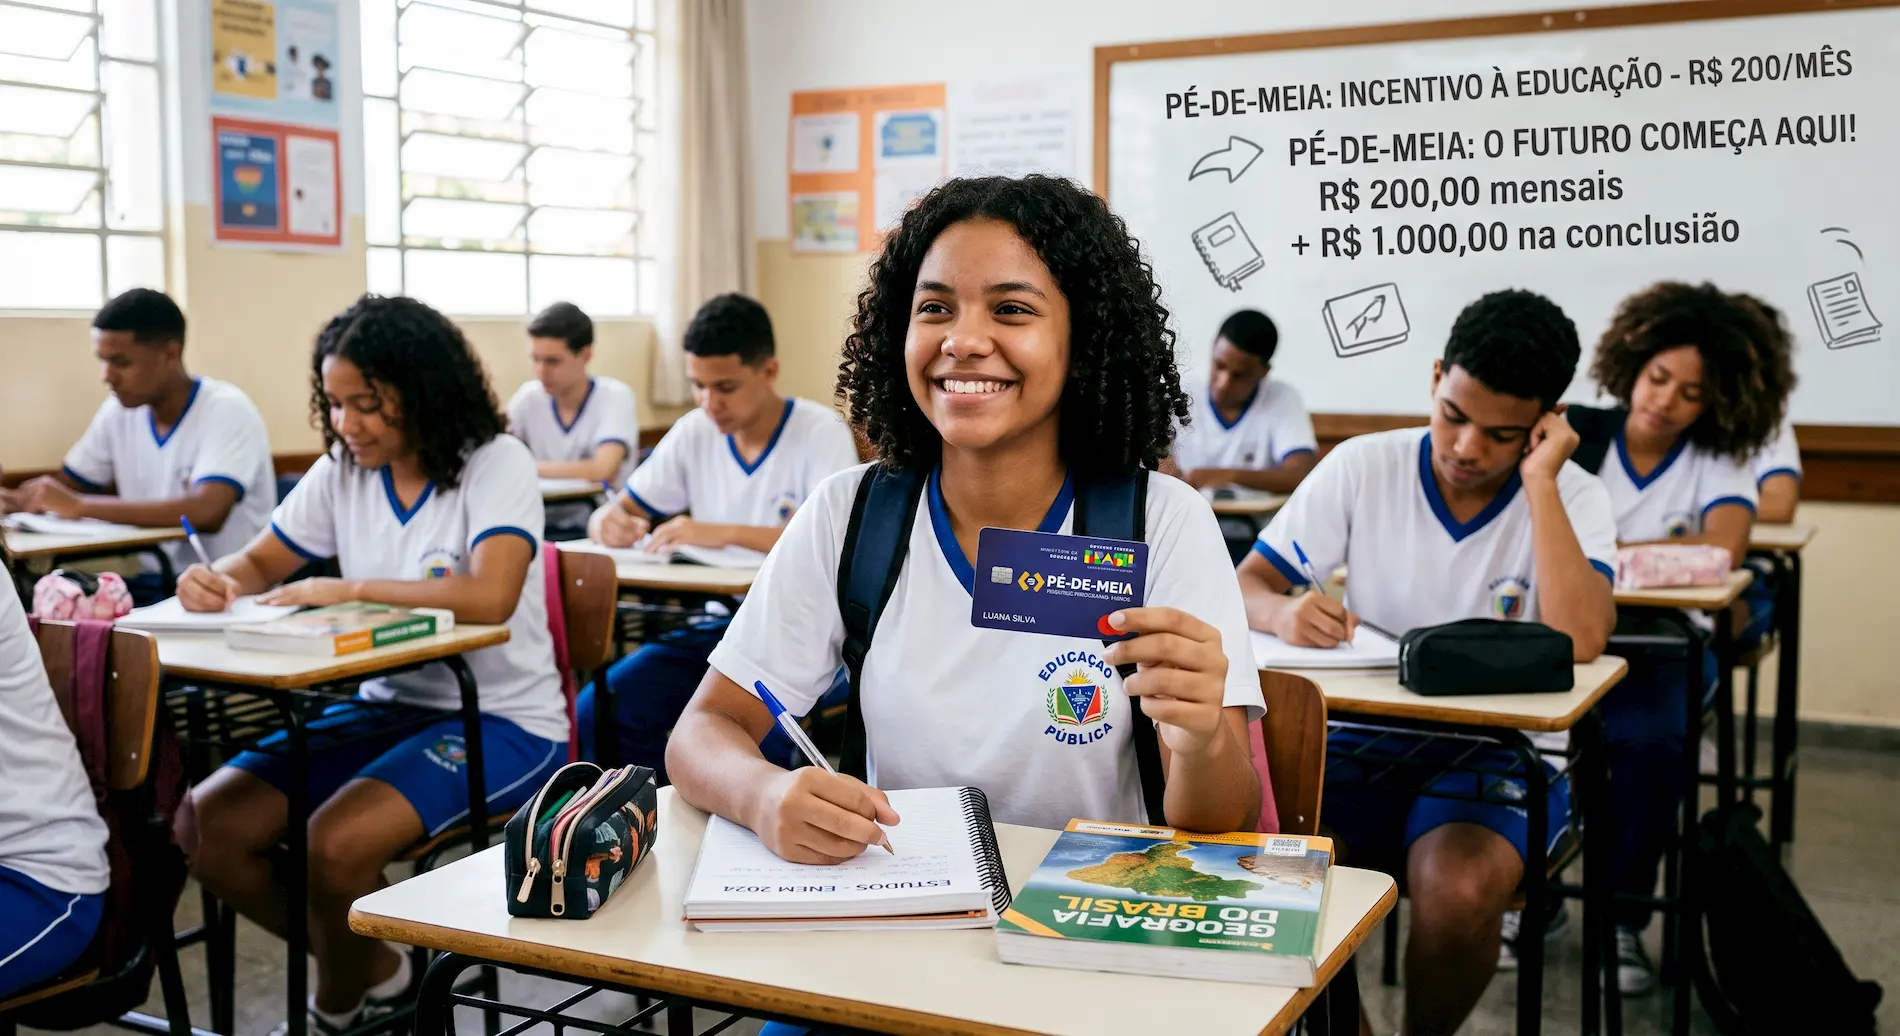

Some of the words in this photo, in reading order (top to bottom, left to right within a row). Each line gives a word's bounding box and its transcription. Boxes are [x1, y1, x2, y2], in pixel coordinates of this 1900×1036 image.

[1165, 84, 1333, 119] PÉ-DE-MEIA:
[1340, 73, 1483, 108] INCENTIVO
[1491, 66, 1509, 99] À
[1516, 56, 1662, 98] EDUCAÇÃO
[1688, 56, 1723, 87] R$
[1730, 44, 1853, 83] 200/MÊS
[1289, 129, 1475, 167] PÉ-DE-MEIA:
[1484, 129, 1504, 158] O
[1513, 123, 1632, 157] FUTURO
[1640, 118, 1768, 156] COMEÇA
[1775, 113, 1856, 147] AQUI!
[1320, 177, 1360, 214] R$
[1370, 176, 1480, 212] 200,00
[1490, 169, 1624, 205] mensais
[1291, 234, 1310, 256] +
[1321, 223, 1362, 261] R$
[1372, 222, 1508, 258] 1.000,00
[1519, 225, 1556, 250] na
[1566, 211, 1740, 249] conclusião
[1083, 549, 1137, 568] BRASIL
[1047, 573, 1133, 596] PÉ-DE-MEIA
[983, 611, 1010, 621] LUANA
[1012, 614, 1036, 624] SILVA
[1044, 722, 1113, 745] PÚBLICA
[723, 885, 771, 893] 2024
[778, 885, 836, 893] ENEM
[856, 879, 951, 891] ESTUDOS
[1058, 895, 1207, 919] BRASIL
[1218, 907, 1279, 924] DO
[1052, 909, 1276, 938] GEOGRAFIA
